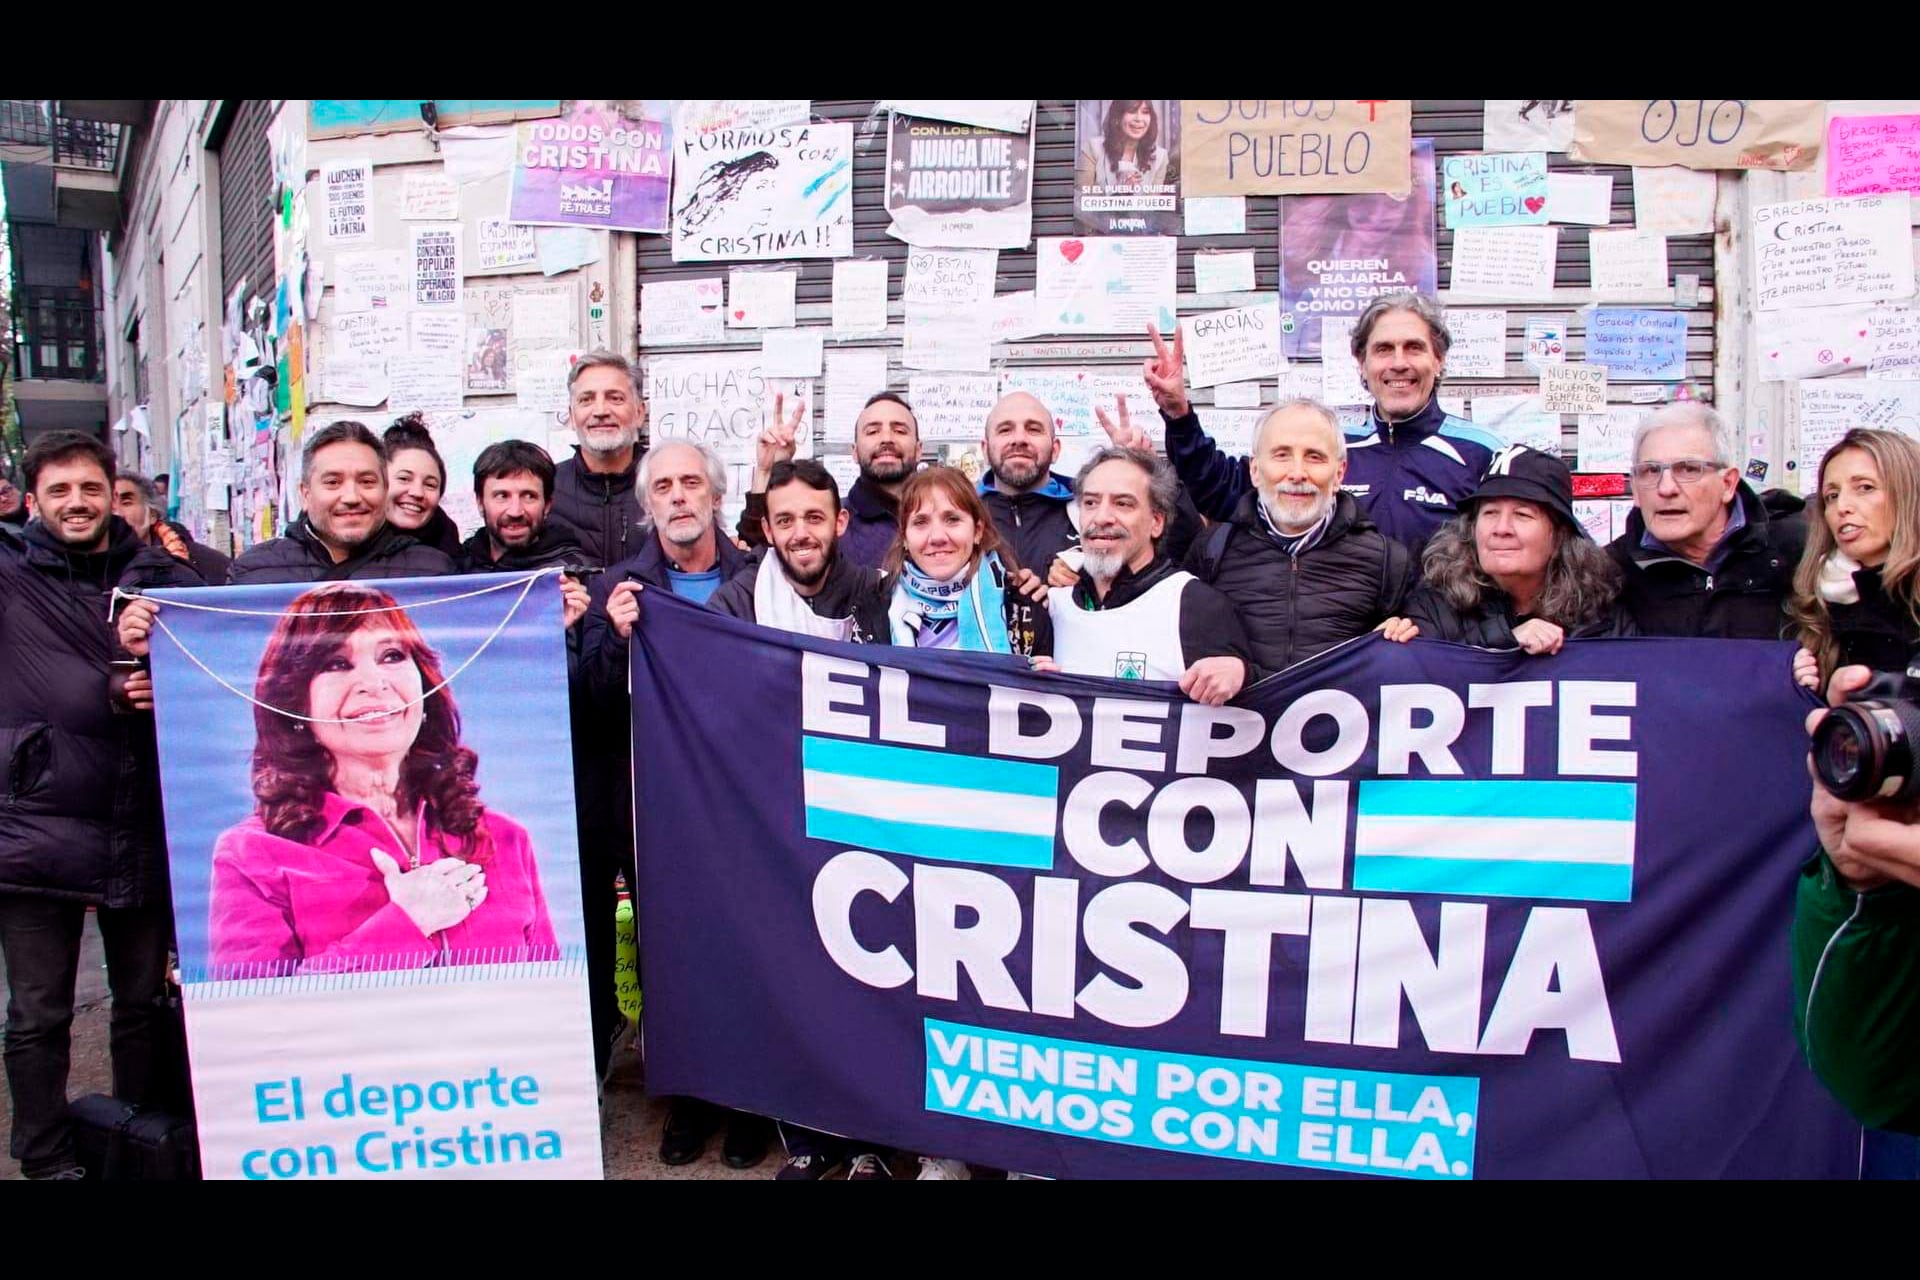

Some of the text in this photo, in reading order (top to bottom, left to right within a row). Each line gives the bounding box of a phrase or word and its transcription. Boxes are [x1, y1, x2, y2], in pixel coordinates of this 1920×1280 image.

[910, 126, 969, 136] CON LOS
[1641, 100, 1745, 147] OJO
[527, 123, 664, 150] TODOS CON
[685, 128, 809, 156] FORMOSA
[522, 144, 664, 175] CRISTINA
[910, 138, 1013, 168] NUNCA ME
[1228, 131, 1371, 180] PUEBLO
[328, 168, 365, 184] ¡LUCHEN!
[1446, 157, 1533, 179] CRISTINA
[1082, 184, 1177, 194] SI EL PUEBLO QUIERE
[1480, 177, 1503, 193] ES
[1083, 198, 1172, 208] CRISTINA PUEDE
[330, 205, 366, 218] EL FUTURO
[329, 222, 366, 236] LA PATRIA
[417, 245, 456, 257] CONCIENCIA
[417, 258, 455, 271] POPULAR
[1307, 259, 1389, 274] QUIEREN
[417, 279, 456, 290] ESPERANDO
[1320, 271, 1406, 285] BAJARLA
[1308, 287, 1321, 298] Y
[1324, 287, 1351, 298] NO
[1194, 309, 1265, 338] GRACIAS
[1594, 312, 1634, 328] Gracias
[1875, 325, 1920, 338] DEJAST
[1548, 368, 1589, 381] NUEVO
[1544, 402, 1595, 413] CRISTINA
[658, 407, 809, 444] GRACIS
[802, 650, 1639, 777] EL DEPORTE
[1062, 770, 1350, 890] CON
[811, 850, 1622, 1064] CRISTINA
[930, 1028, 1474, 1138] VIENEN POR ELLA,
[254, 1067, 540, 1127] El deporte
[930, 1068, 1469, 1177] VAMOS CON ELLA.
[241, 1121, 563, 1180] con Cristina
